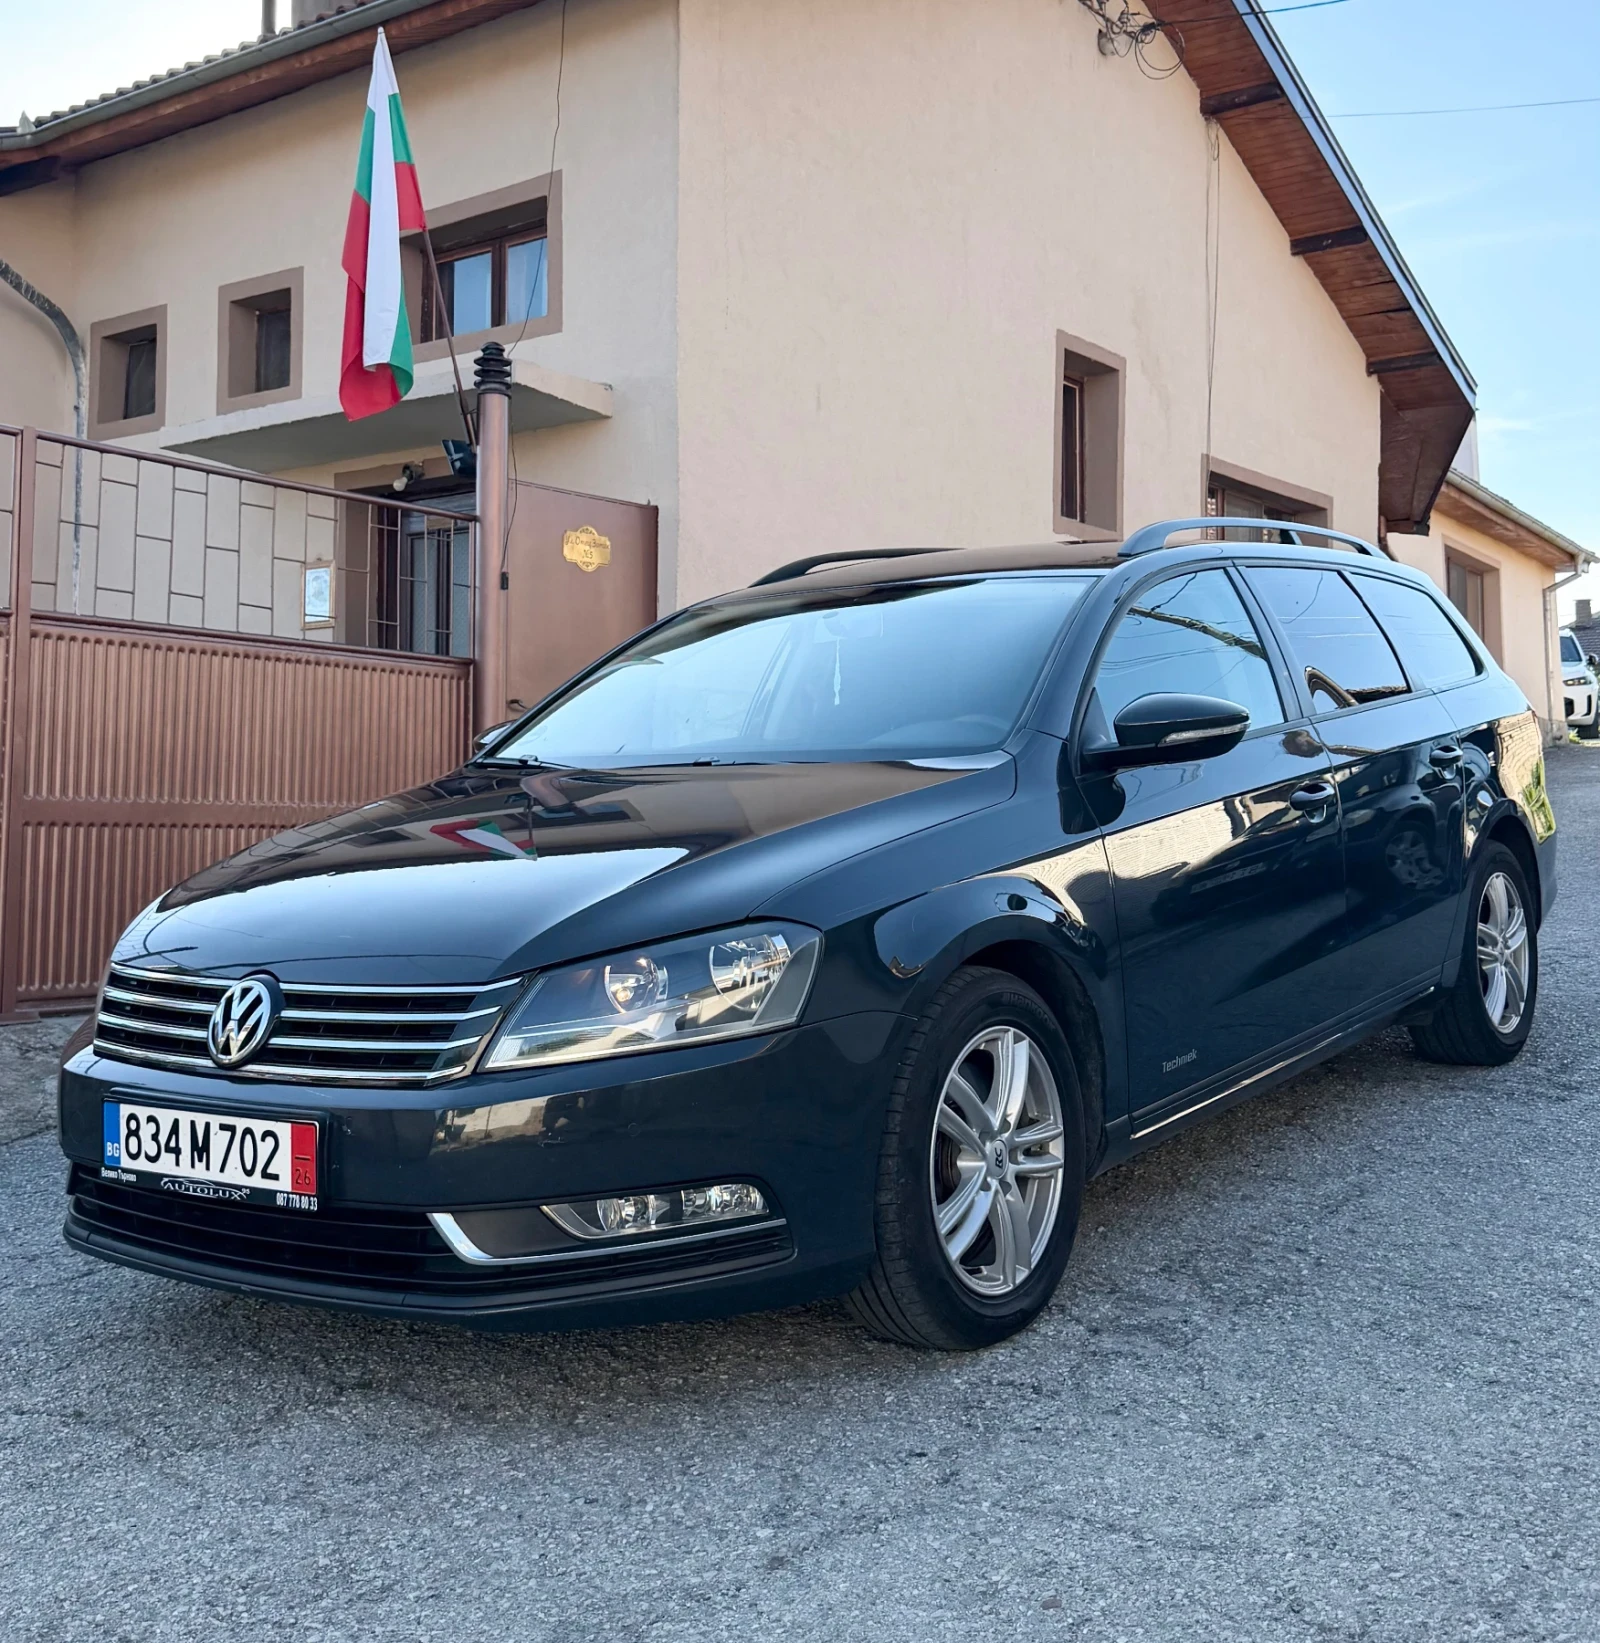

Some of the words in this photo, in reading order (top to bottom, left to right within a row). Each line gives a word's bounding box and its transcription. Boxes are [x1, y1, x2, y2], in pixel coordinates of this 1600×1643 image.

[106, 1142, 120, 1157] BG
[295, 1168, 311, 1186] 26
[309, 1196, 318, 1211] 33
